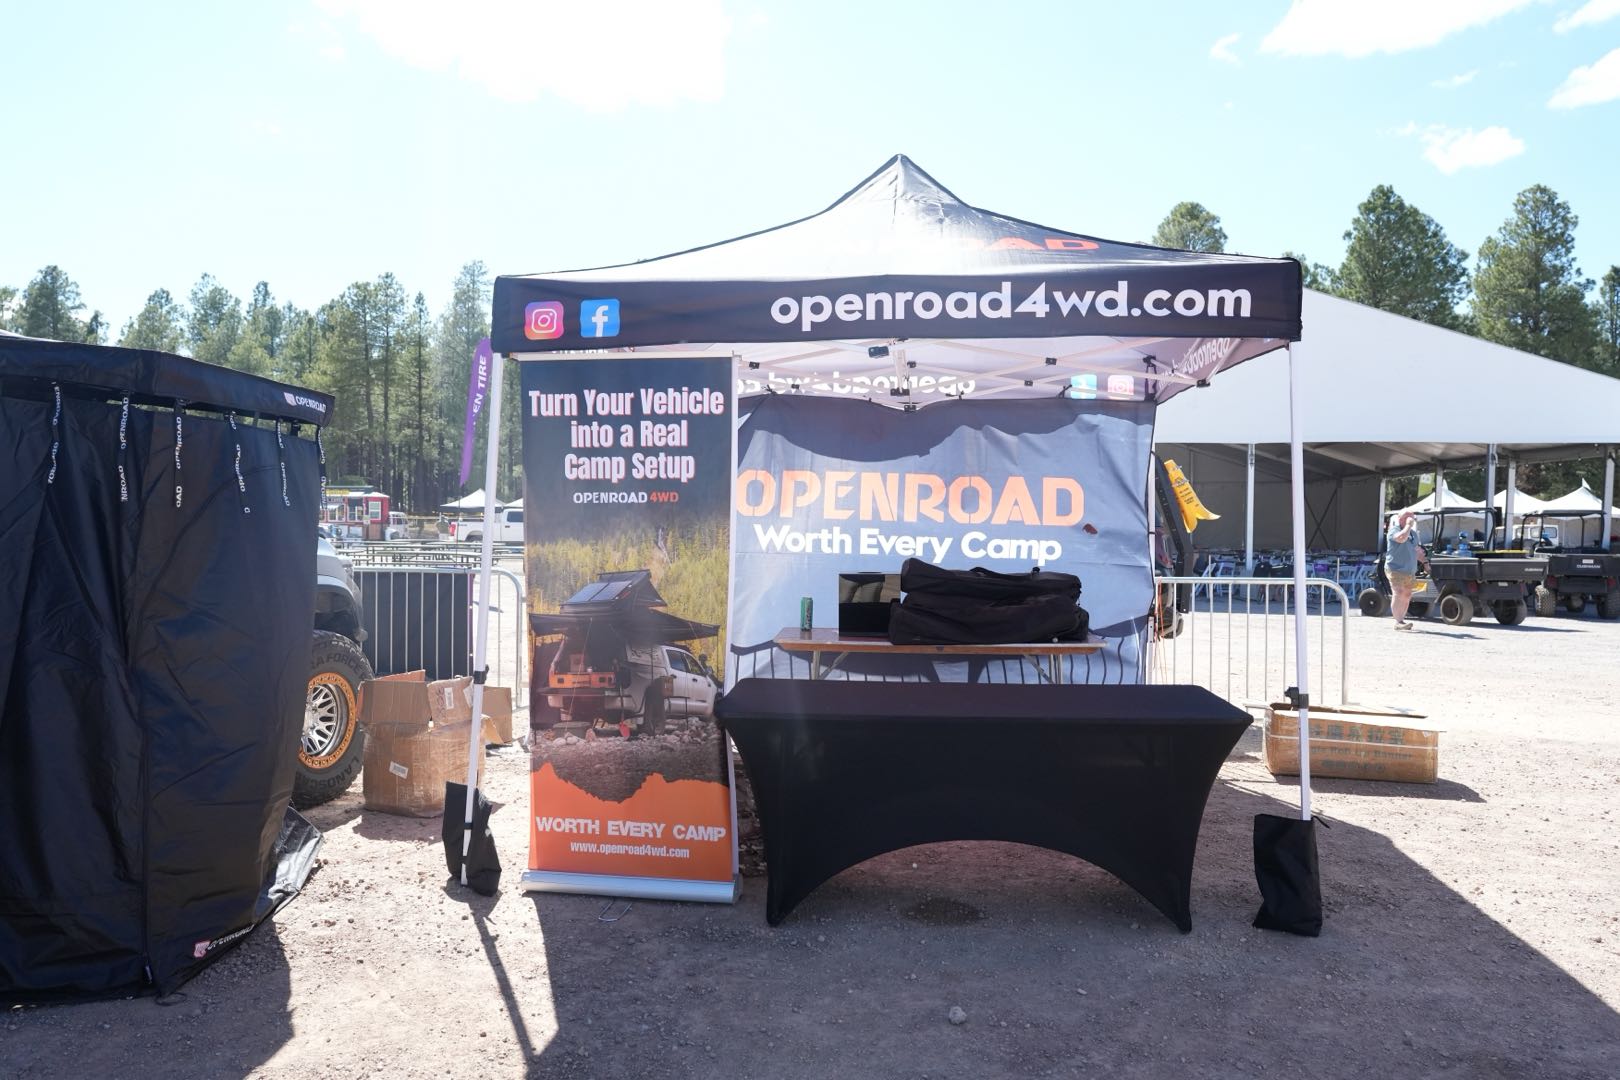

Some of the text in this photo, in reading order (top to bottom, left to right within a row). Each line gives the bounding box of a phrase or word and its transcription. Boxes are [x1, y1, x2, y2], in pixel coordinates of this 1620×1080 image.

[770, 280, 1252, 331] openroad4wd.com
[478, 354, 488, 389] TIRE
[295, 396, 327, 413] OPENROAD
[528, 386, 725, 417] Turn Your Vehicle
[120, 397, 130, 450] OPENROAD
[570, 419, 689, 448] into a Real
[564, 452, 696, 484] Camp Setup
[573, 491, 679, 504] OPENROAD 4WD
[736, 468, 1085, 527] OPENROAD
[754, 524, 1062, 566] Worth Every Camp
[536, 816, 726, 843] WORTH EVERY CAMP
[570, 841, 690, 859] www.openroad4wd.com
